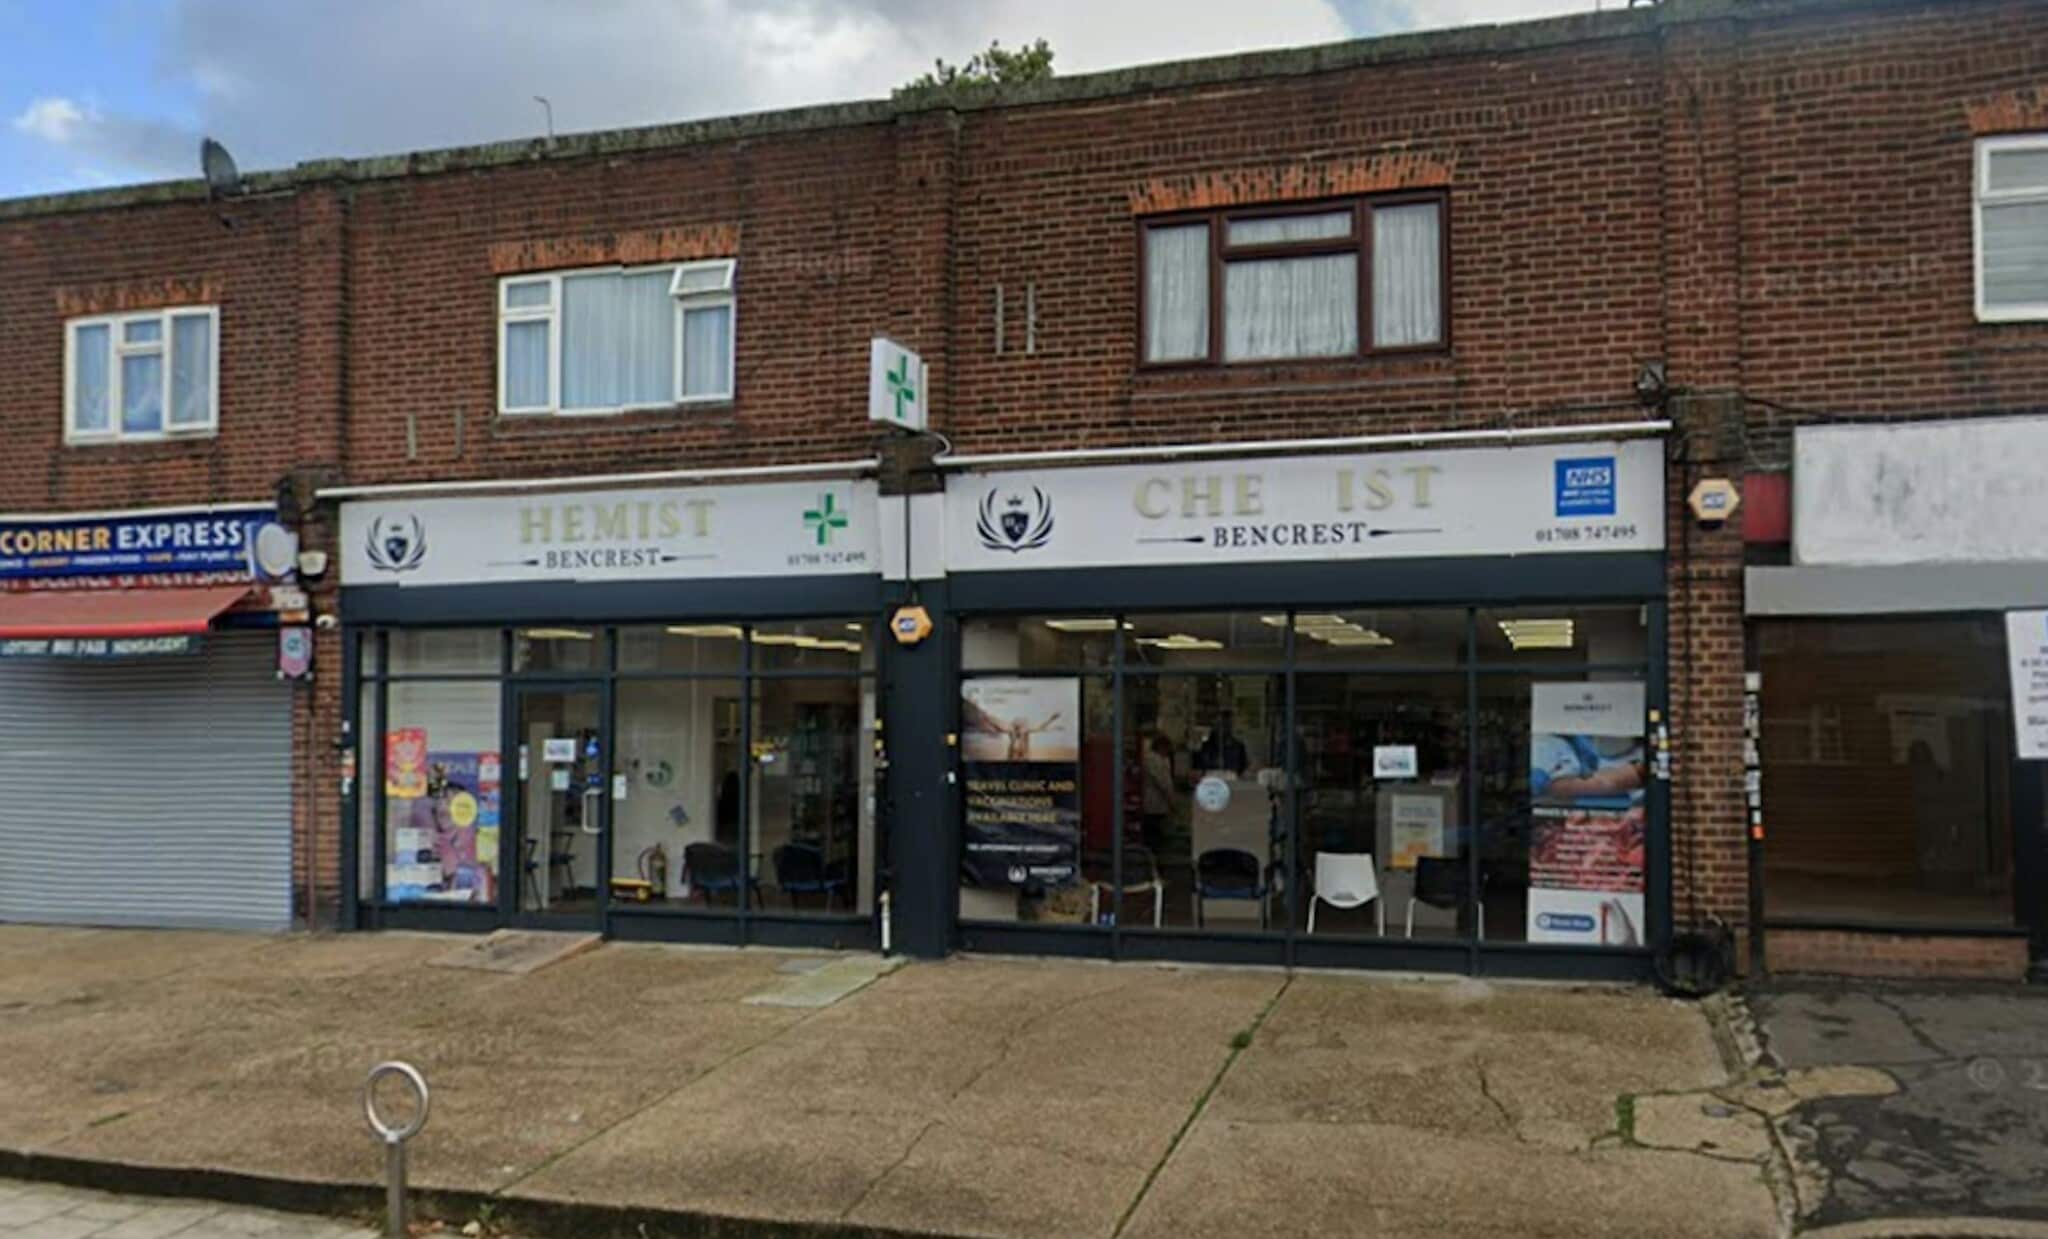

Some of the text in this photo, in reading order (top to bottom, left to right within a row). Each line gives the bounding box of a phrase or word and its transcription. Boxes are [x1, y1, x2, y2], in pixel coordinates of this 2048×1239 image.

[1134, 465, 1443, 519] CHE IST
[1568, 469, 1609, 486] NHS
[518, 500, 716, 543] HEMIST
[1213, 522, 1367, 547] BENCREST
[0, 521, 242, 554] CORNER EXPRESS
[546, 549, 660, 569] BENCREST
